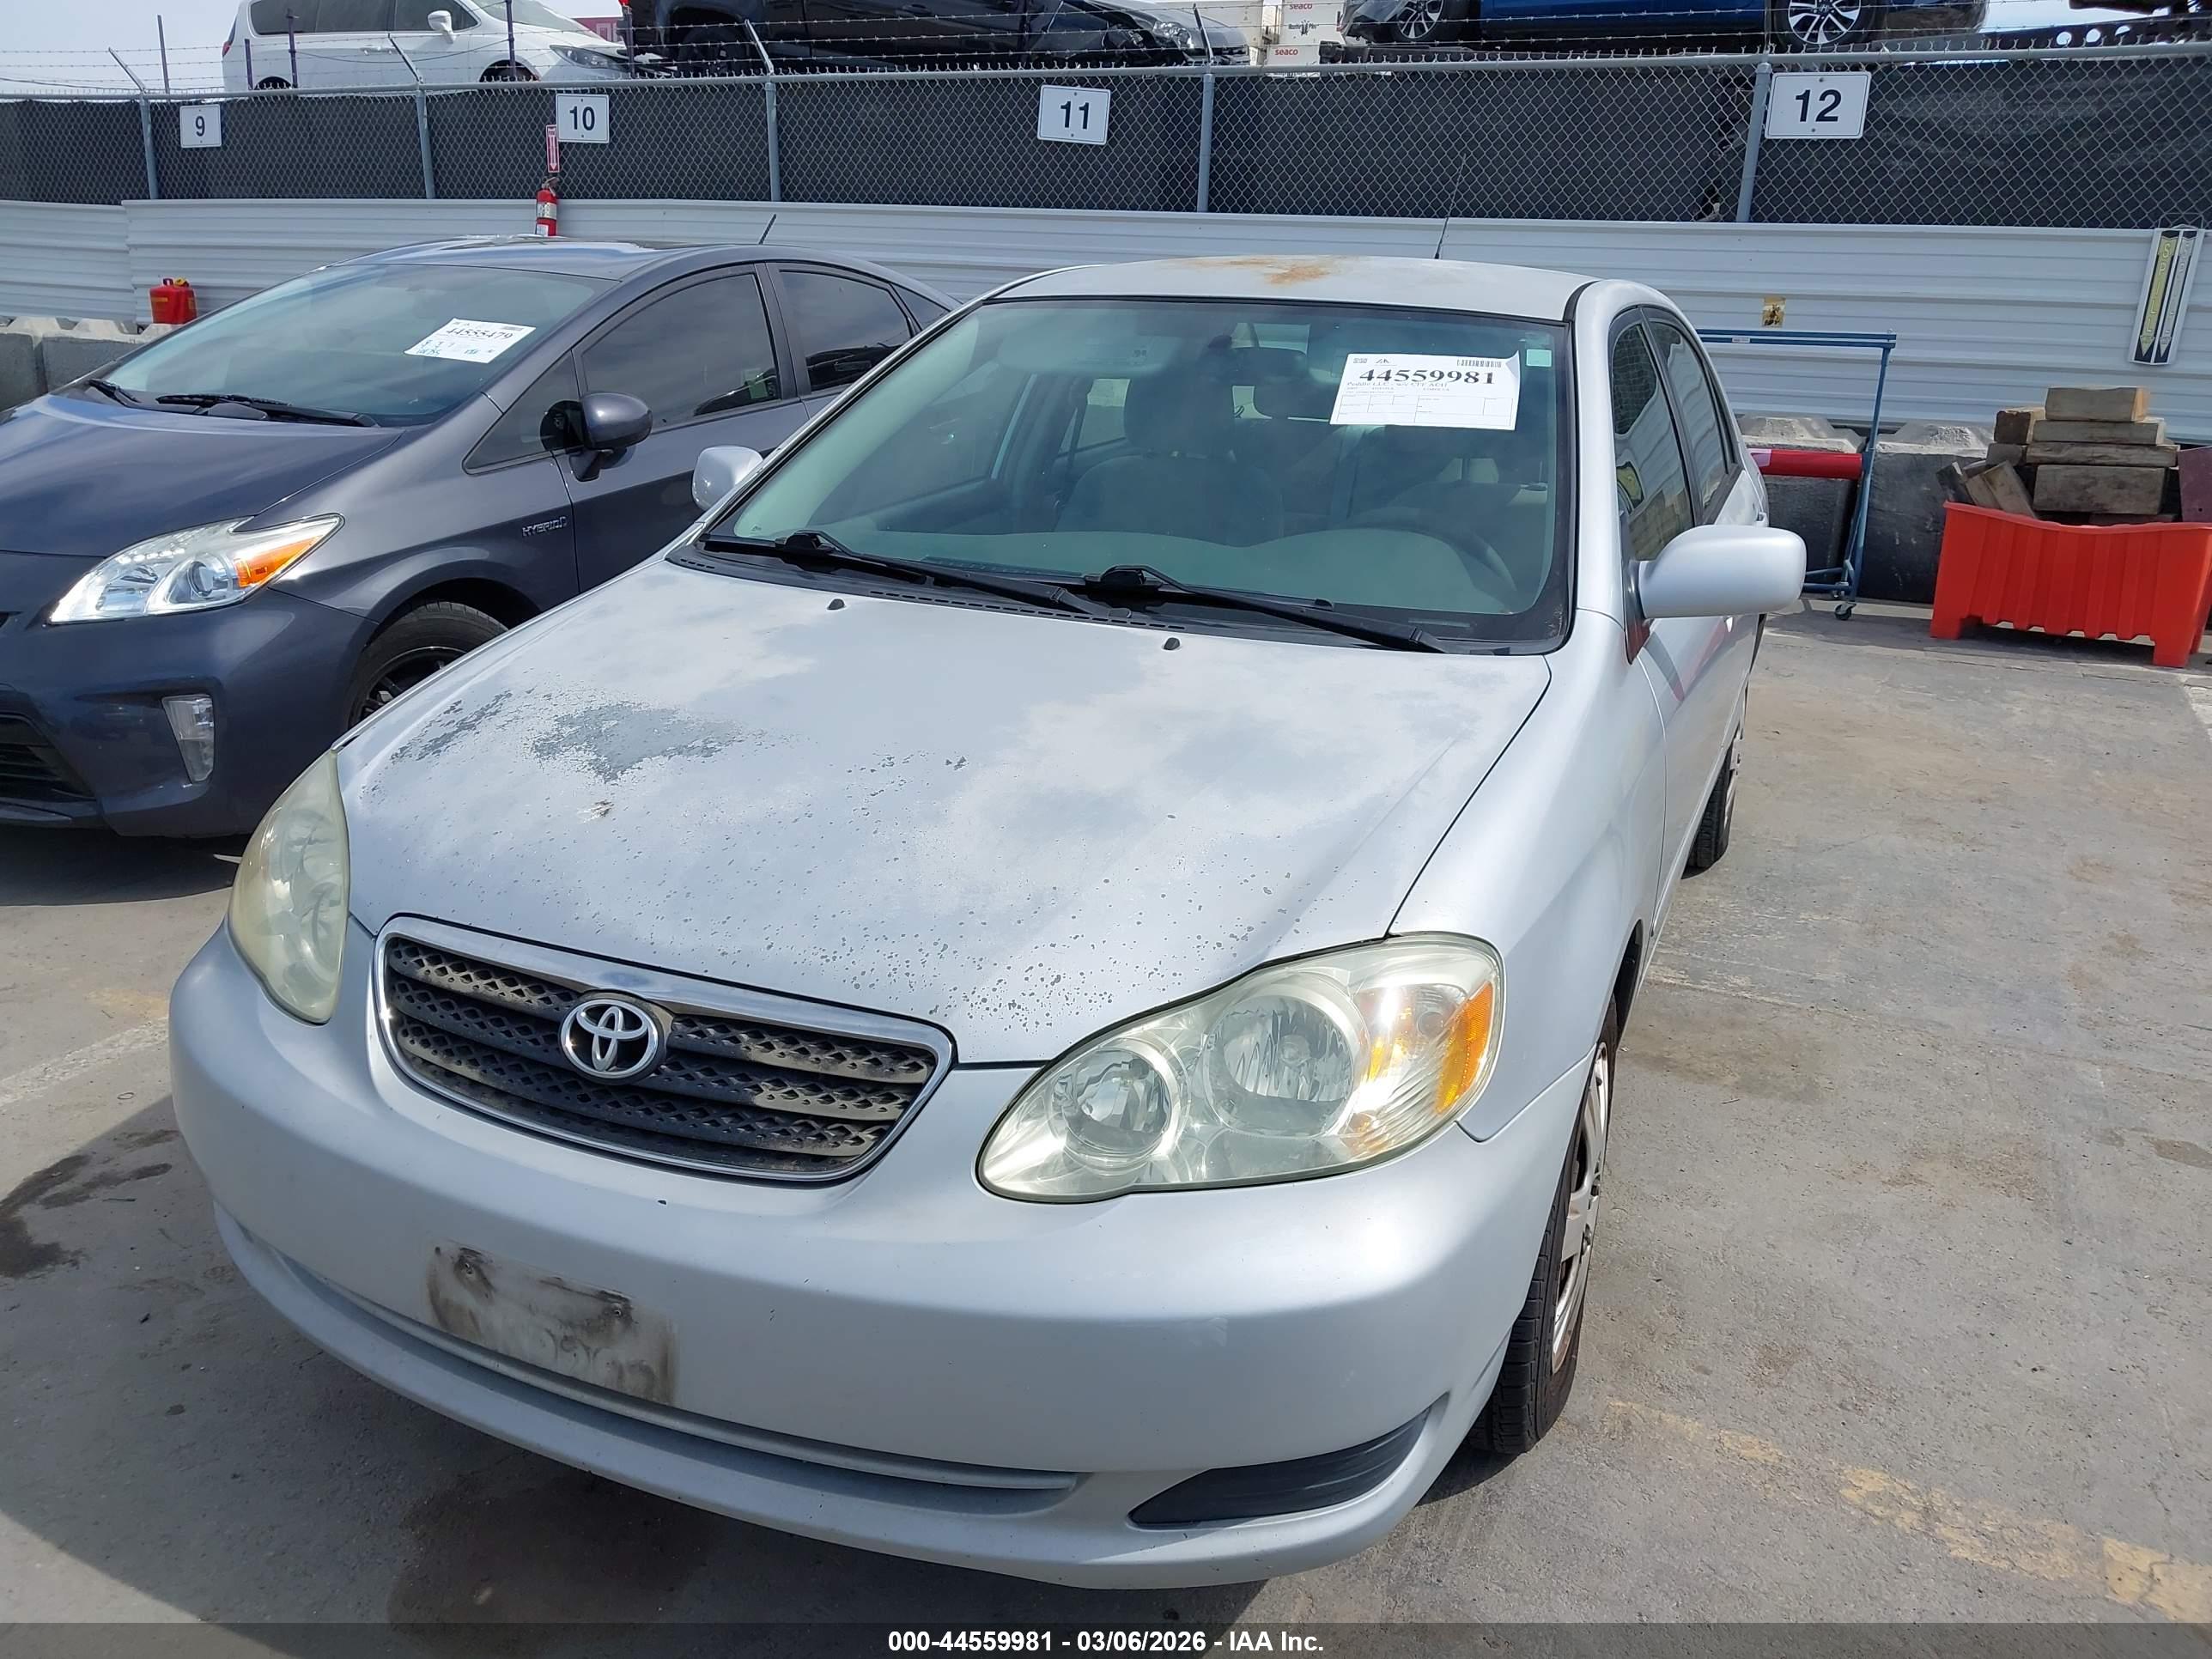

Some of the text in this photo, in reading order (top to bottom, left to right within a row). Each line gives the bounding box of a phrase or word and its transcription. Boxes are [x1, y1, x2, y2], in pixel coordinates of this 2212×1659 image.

[1060, 100, 1090, 130] 11
[1795, 88, 1842, 122] 12
[195, 115, 205, 137] 9
[569, 106, 596, 131] 10
[2147, 242, 2172, 333] SPILL
[1359, 369, 1495, 385] 44559981
[522, 516, 568, 537] HYBRID
